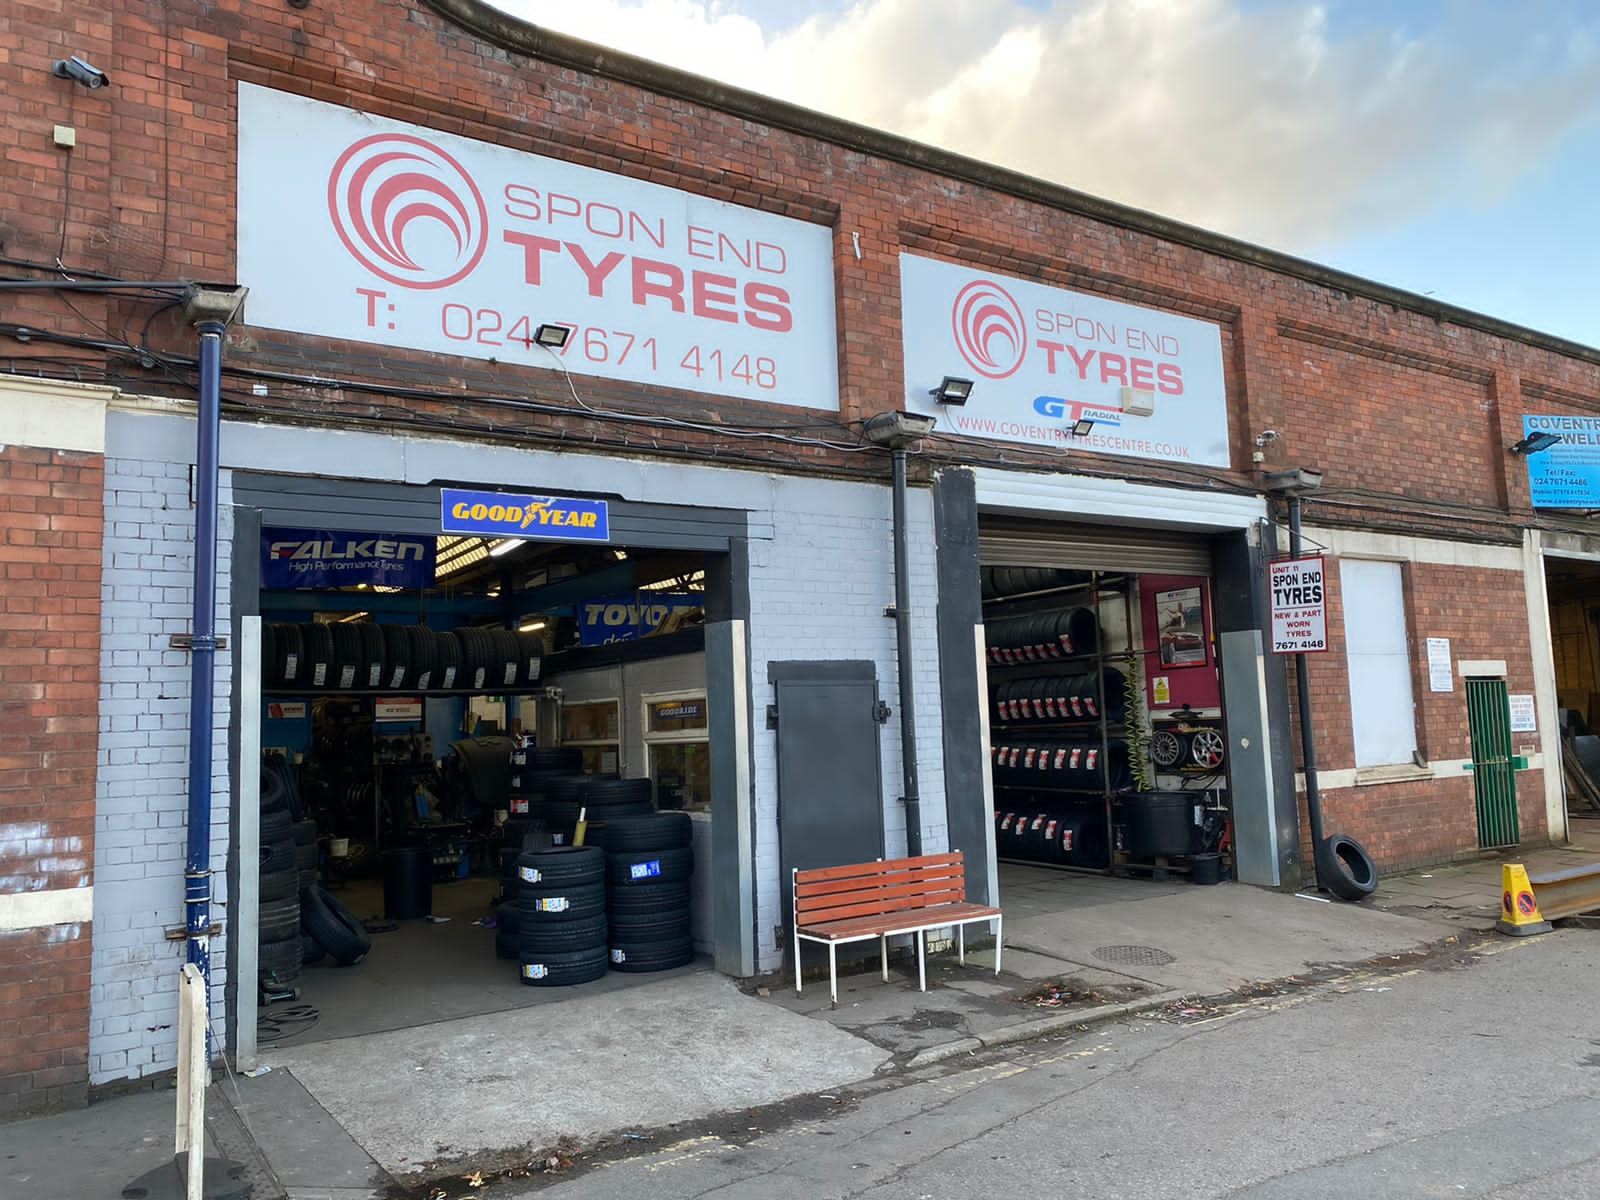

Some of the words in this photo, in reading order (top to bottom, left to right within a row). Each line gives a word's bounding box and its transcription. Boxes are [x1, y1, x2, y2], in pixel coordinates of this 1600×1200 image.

[504, 183, 665, 249] SPON
[687, 224, 787, 275] END
[502, 229, 793, 333] TYRES
[356, 287, 396, 331] T:
[442, 303, 533, 351] 024
[554, 321, 658, 371] 7671
[680, 344, 777, 390] 4148
[1036, 308, 1117, 345] SPON
[1126, 327, 1180, 357] END
[1036, 339, 1184, 396] TYRES
[1083, 409, 1122, 421] RADIAL
[270, 539, 425, 561] FALKEN
[288, 560, 314, 573] High
[1272, 566, 1290, 574] UNIT
[1273, 574, 1299, 588] SPON
[1302, 571, 1321, 584] END
[1273, 585, 1322, 606] TYRES
[1274, 611, 1291, 620] NEW
[1302, 609, 1322, 618] PART
[1286, 620, 1311, 628] WORN
[1286, 630, 1312, 638] TYRES
[1275, 641, 1298, 650] 7671
[1301, 640, 1324, 648] 4148
